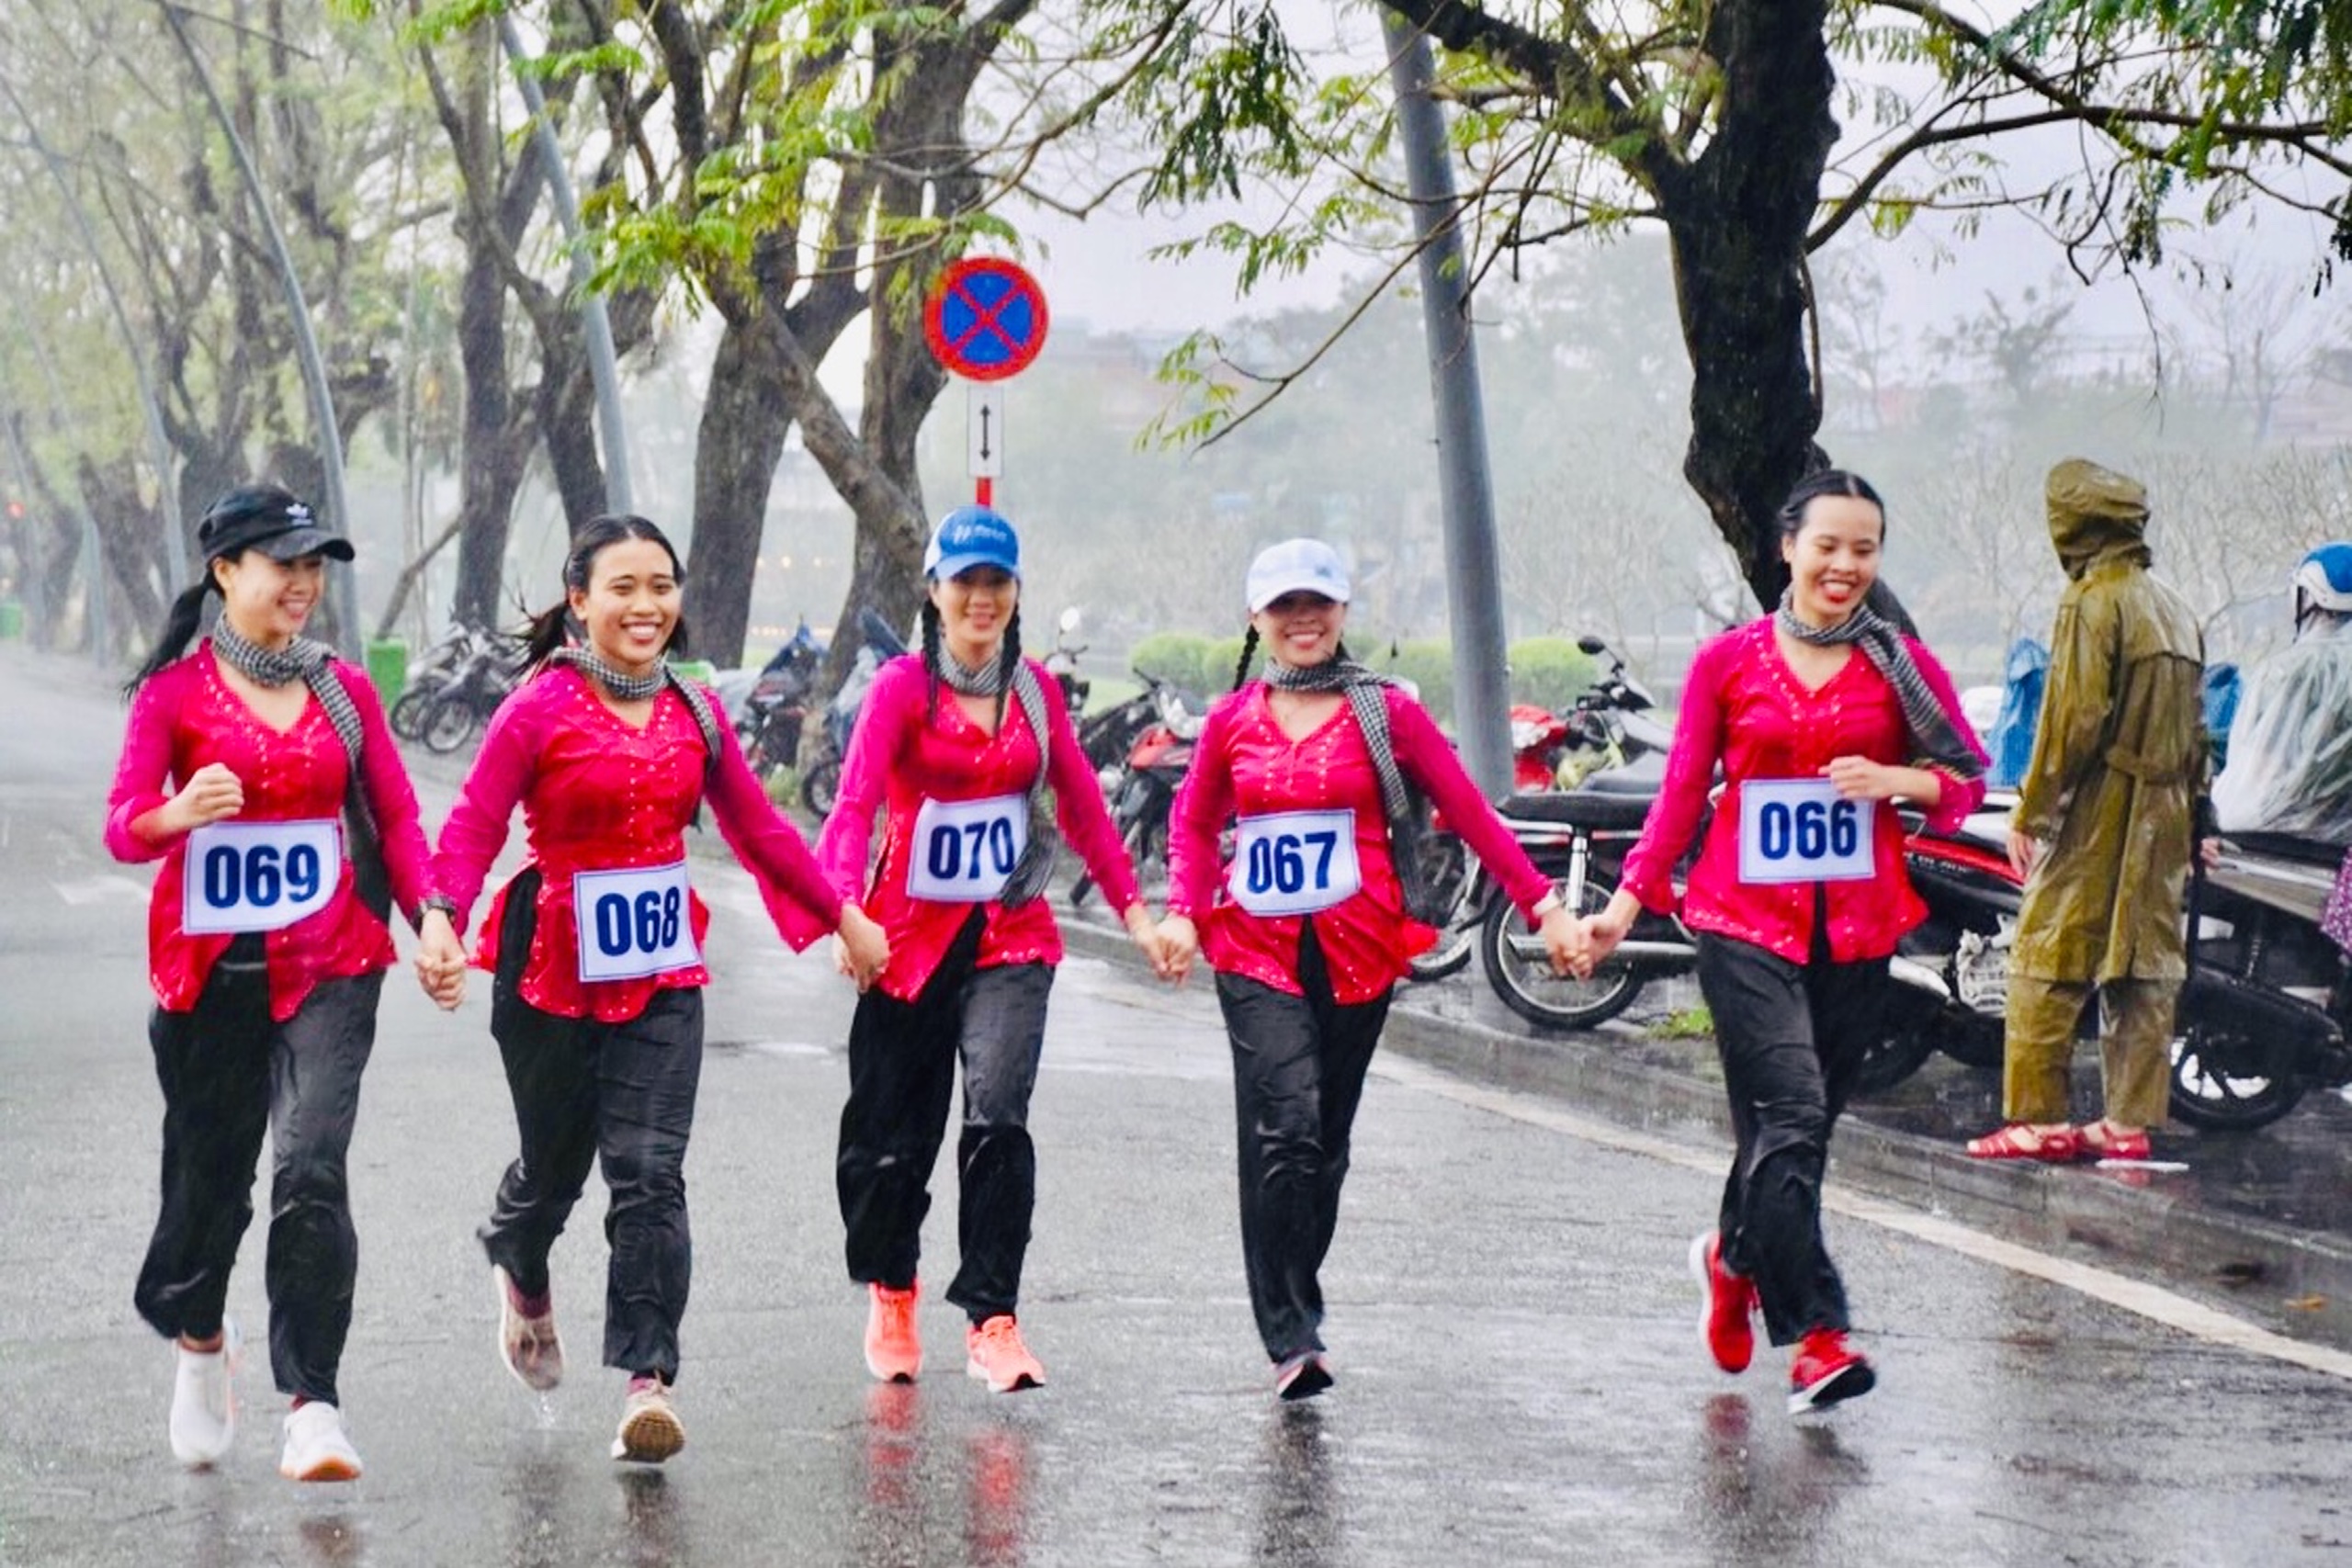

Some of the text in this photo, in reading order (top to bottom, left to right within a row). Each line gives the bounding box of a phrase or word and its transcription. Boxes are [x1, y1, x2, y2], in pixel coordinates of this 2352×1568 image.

[928, 816, 1016, 881] 070
[1246, 830, 1337, 896] 067
[1758, 799, 1859, 862] 066
[204, 842, 320, 909] 069
[595, 885, 681, 957] 068
